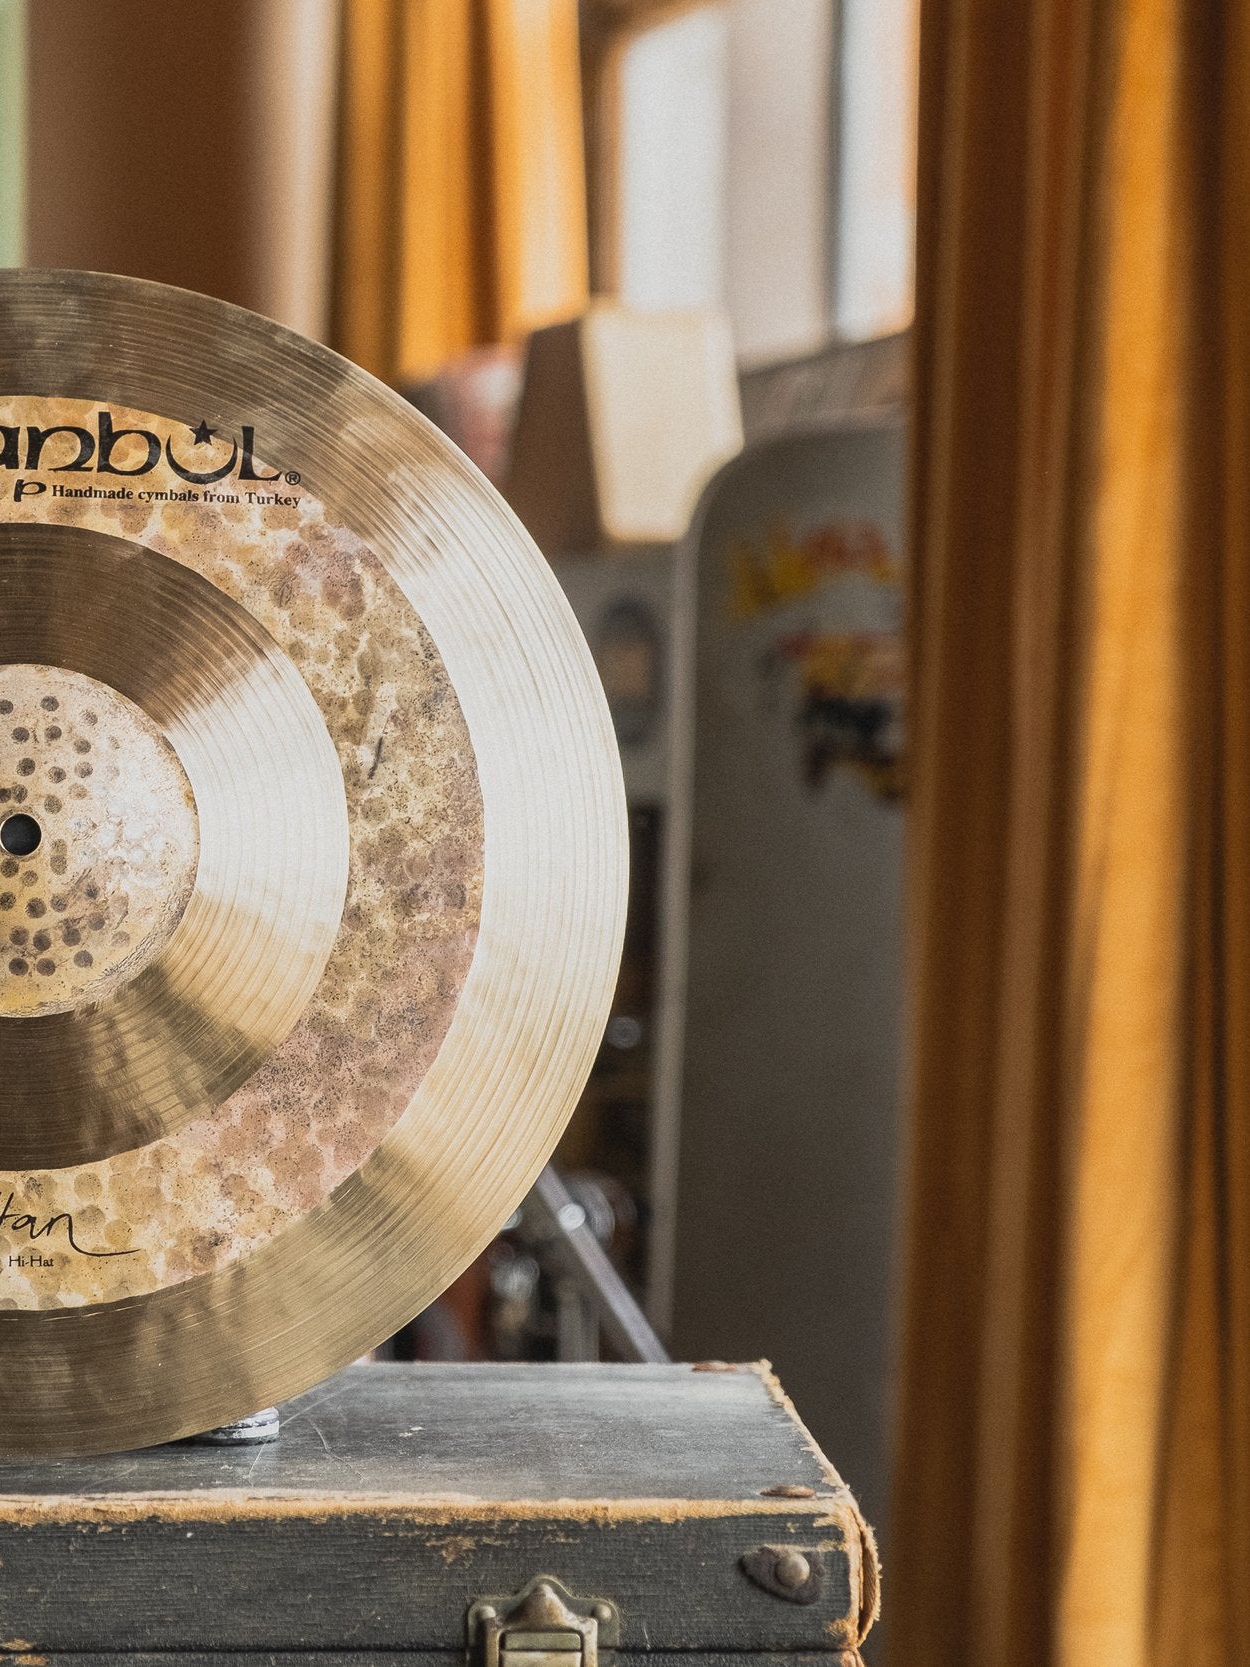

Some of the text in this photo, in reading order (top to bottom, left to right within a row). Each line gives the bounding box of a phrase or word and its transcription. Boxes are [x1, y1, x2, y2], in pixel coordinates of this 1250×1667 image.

[51, 484, 302, 509] Handmade cymbals from Turkey
[8, 1255, 55, 1268] Hi-Hat
